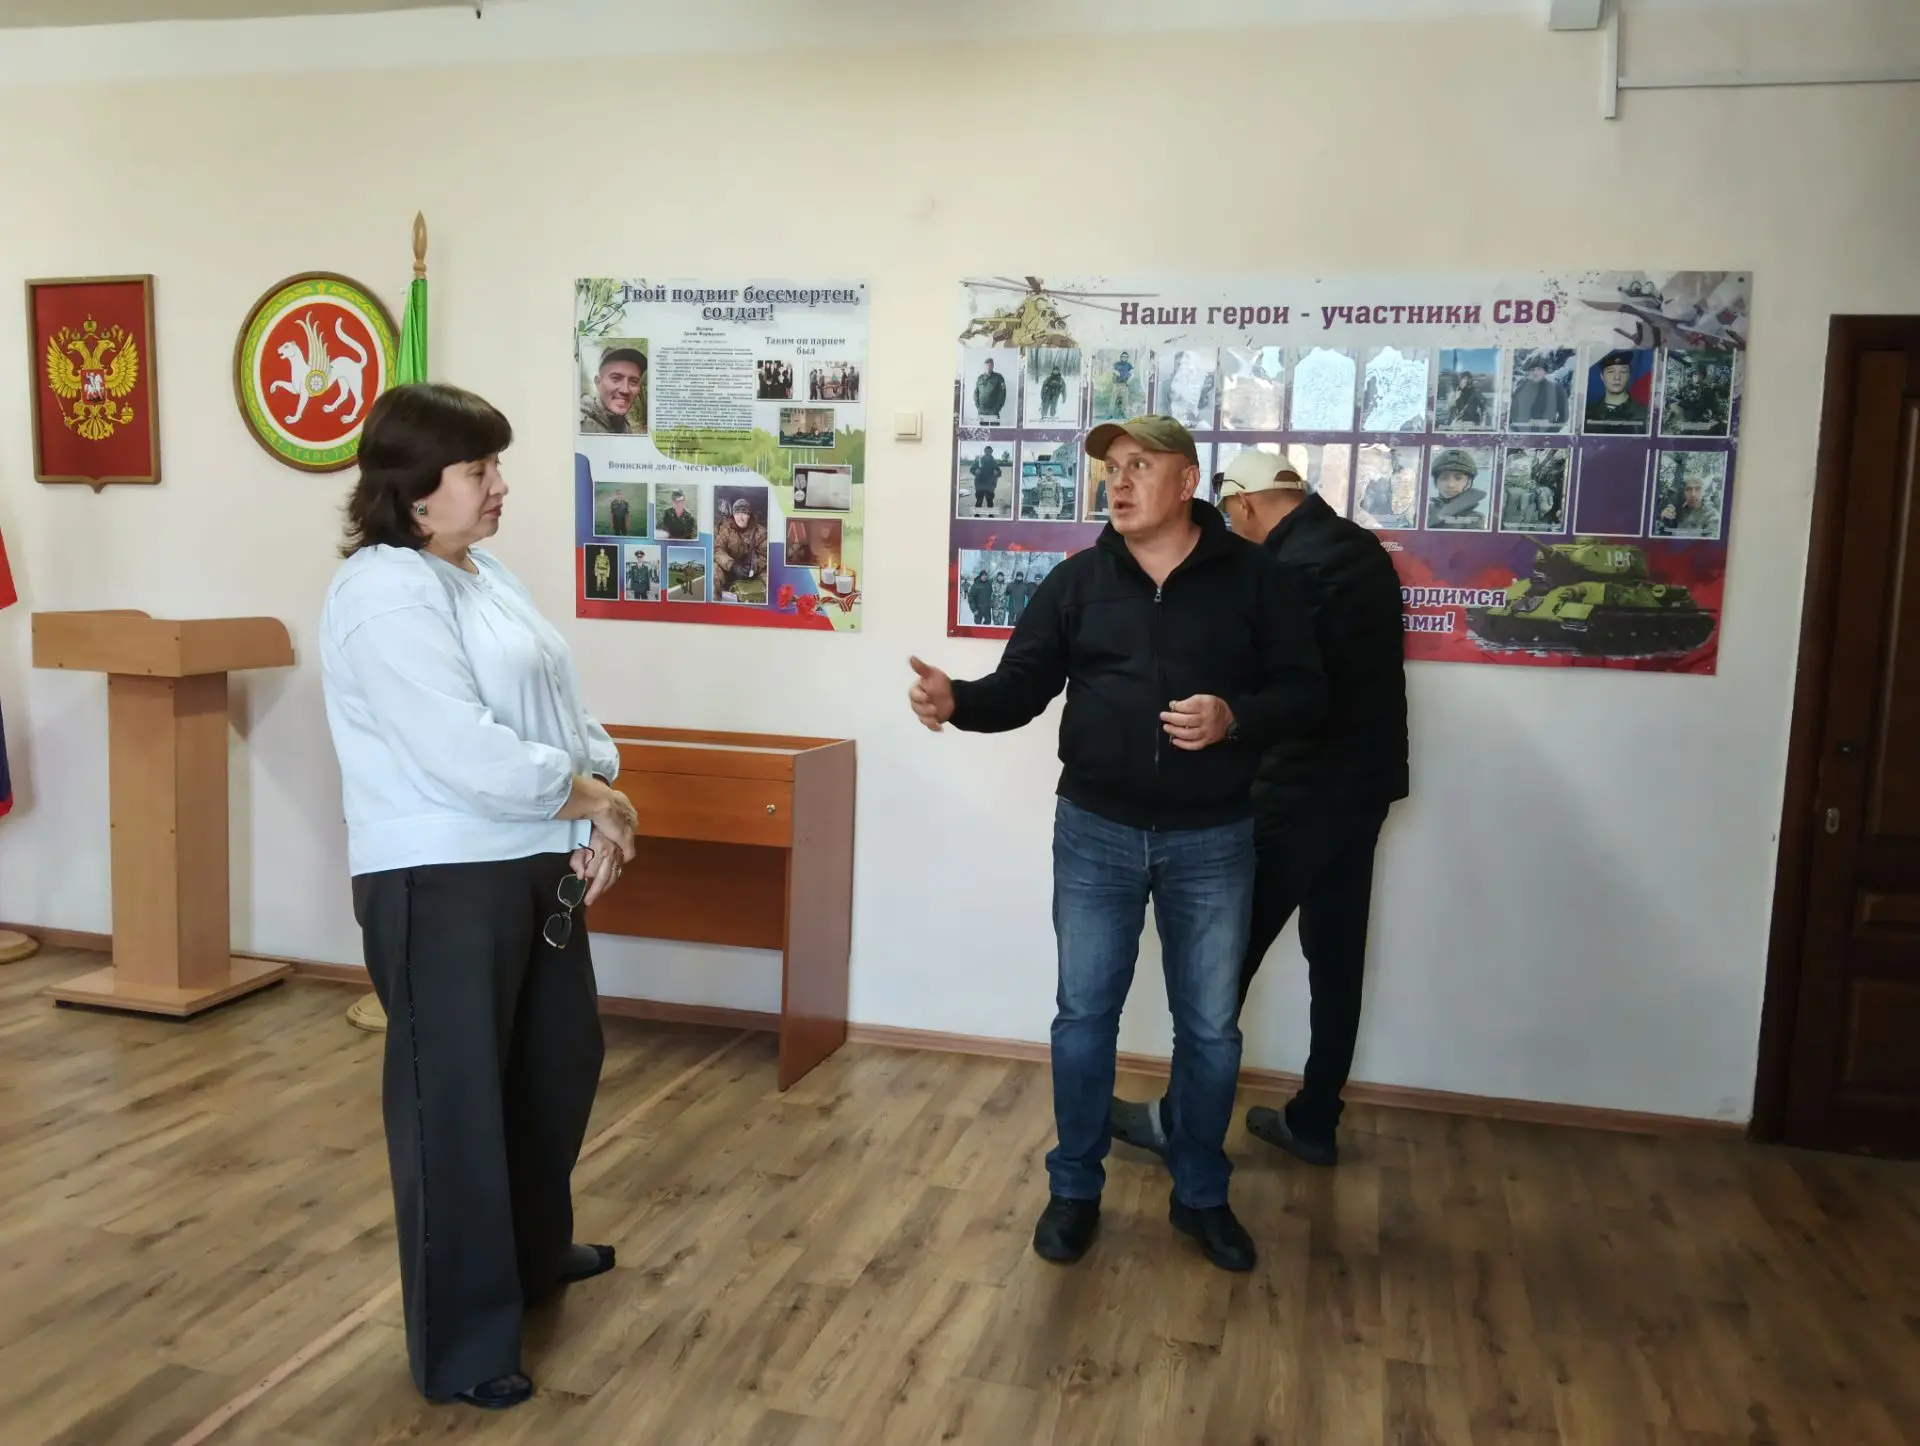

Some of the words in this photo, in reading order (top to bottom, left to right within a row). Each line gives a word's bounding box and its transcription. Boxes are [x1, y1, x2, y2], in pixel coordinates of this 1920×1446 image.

[620, 285, 667, 302] Твой
[671, 289, 738, 304] подвиг
[743, 285, 859, 306] бессмертен,
[702, 304, 774, 323] солдат!
[1119, 302, 1197, 325] Наши
[1207, 306, 1290, 330] герои
[1321, 305, 1482, 330] участники
[1493, 299, 1556, 324] СВО
[765, 336, 794, 345] Таким
[796, 338, 808, 346] он
[810, 338, 845, 348] парнем
[796, 347, 815, 355] был
[608, 460, 653, 471] Воинский
[655, 464, 676, 472] долг
[684, 464, 710, 473] честь
[1400, 587, 1506, 607] ордимся
[1402, 612, 1455, 632] ами!
